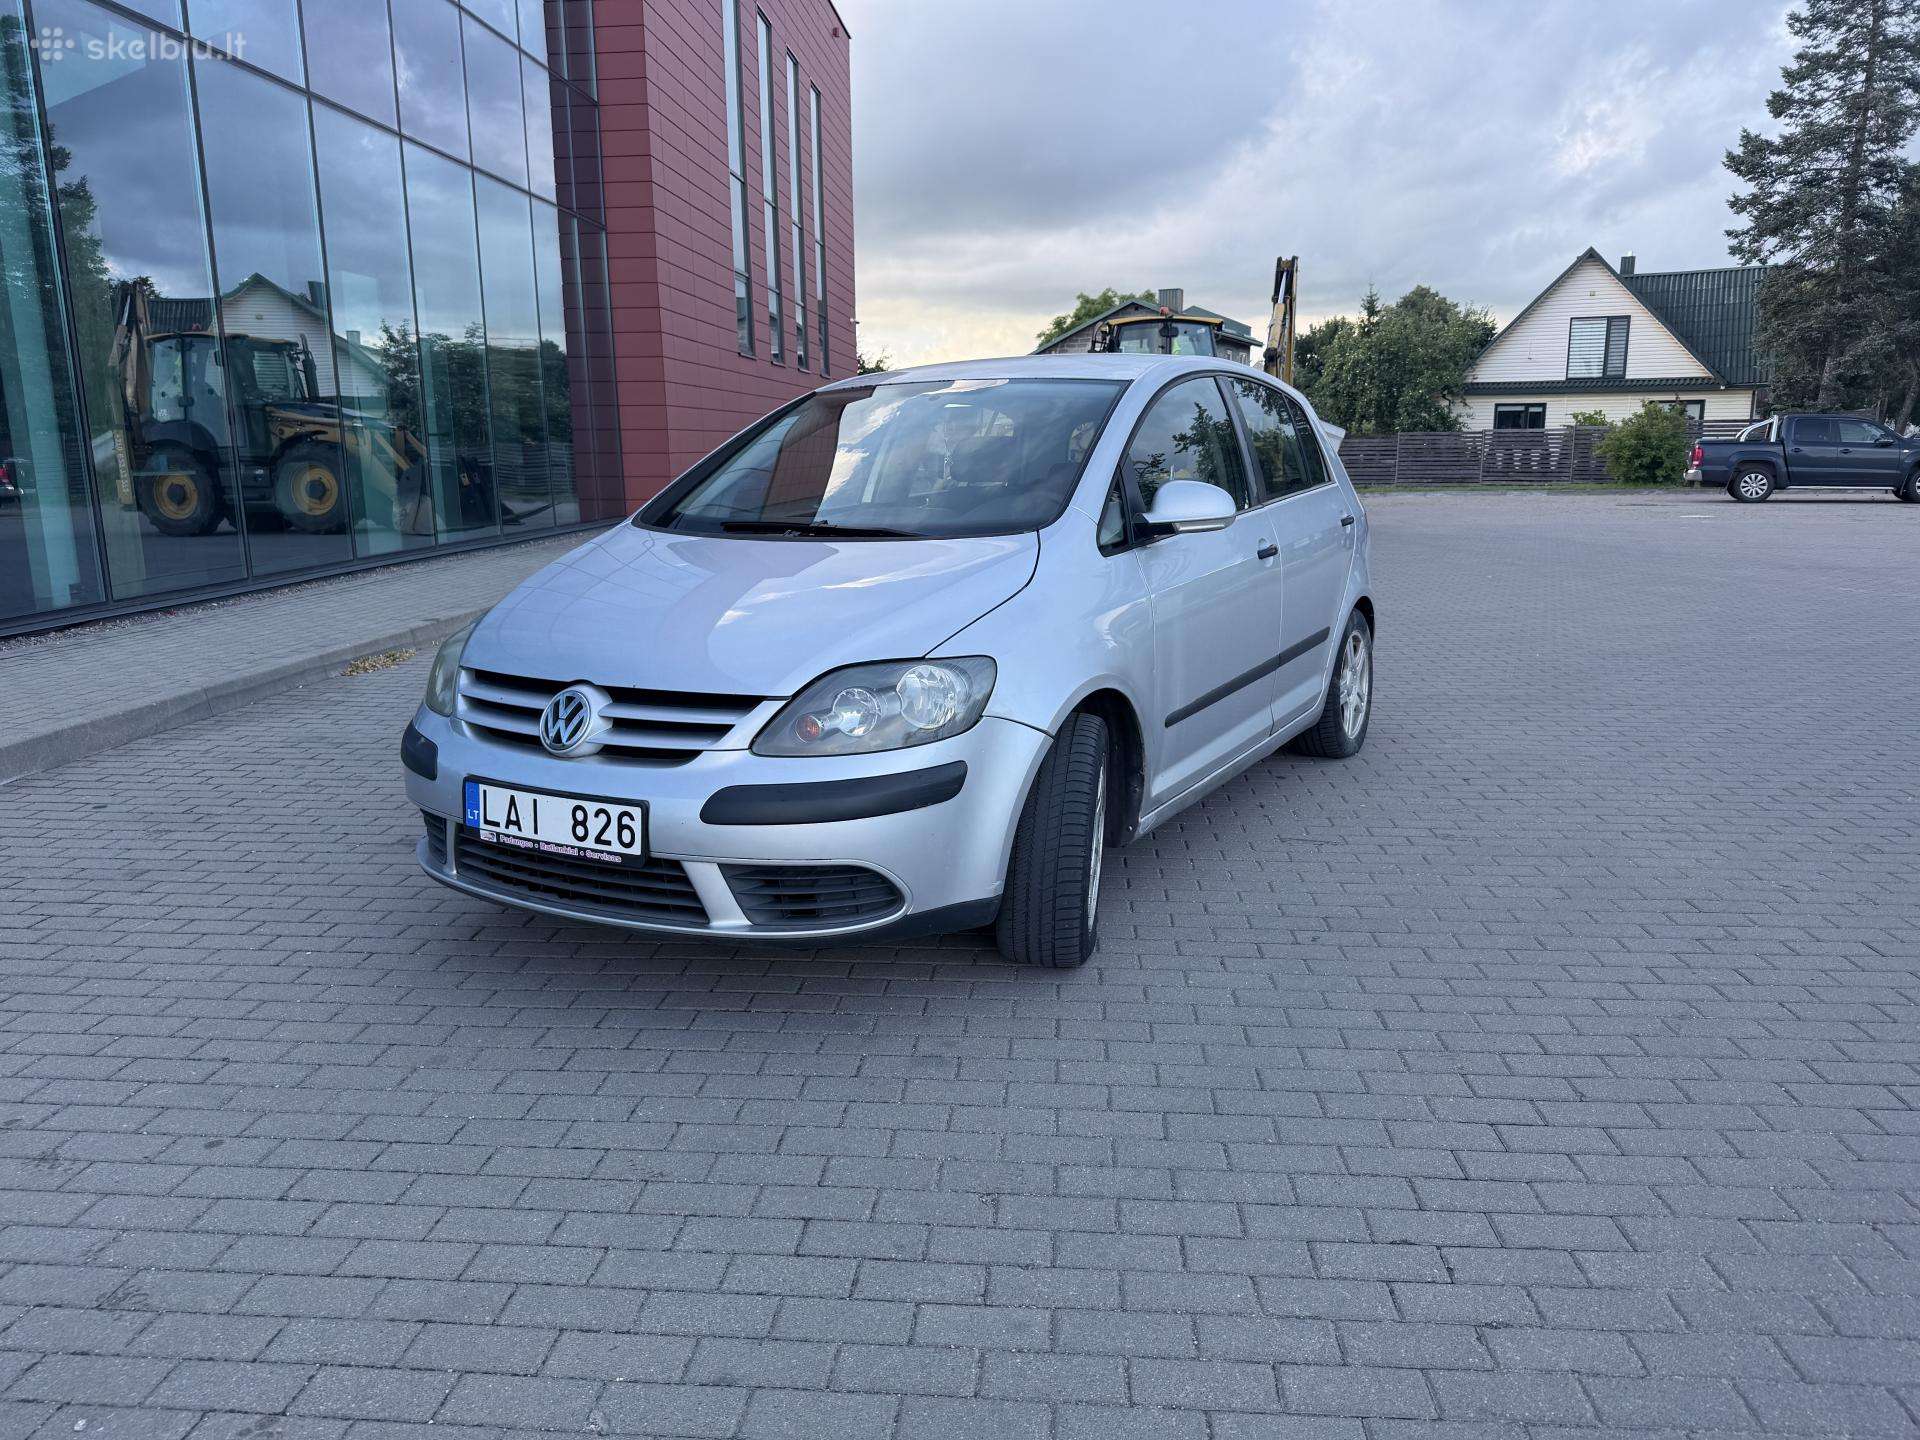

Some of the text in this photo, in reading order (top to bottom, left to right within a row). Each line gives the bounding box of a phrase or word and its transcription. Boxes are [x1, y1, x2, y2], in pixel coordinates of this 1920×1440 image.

[466, 808, 480, 820] LT
[482, 789, 636, 849] LAI 826
